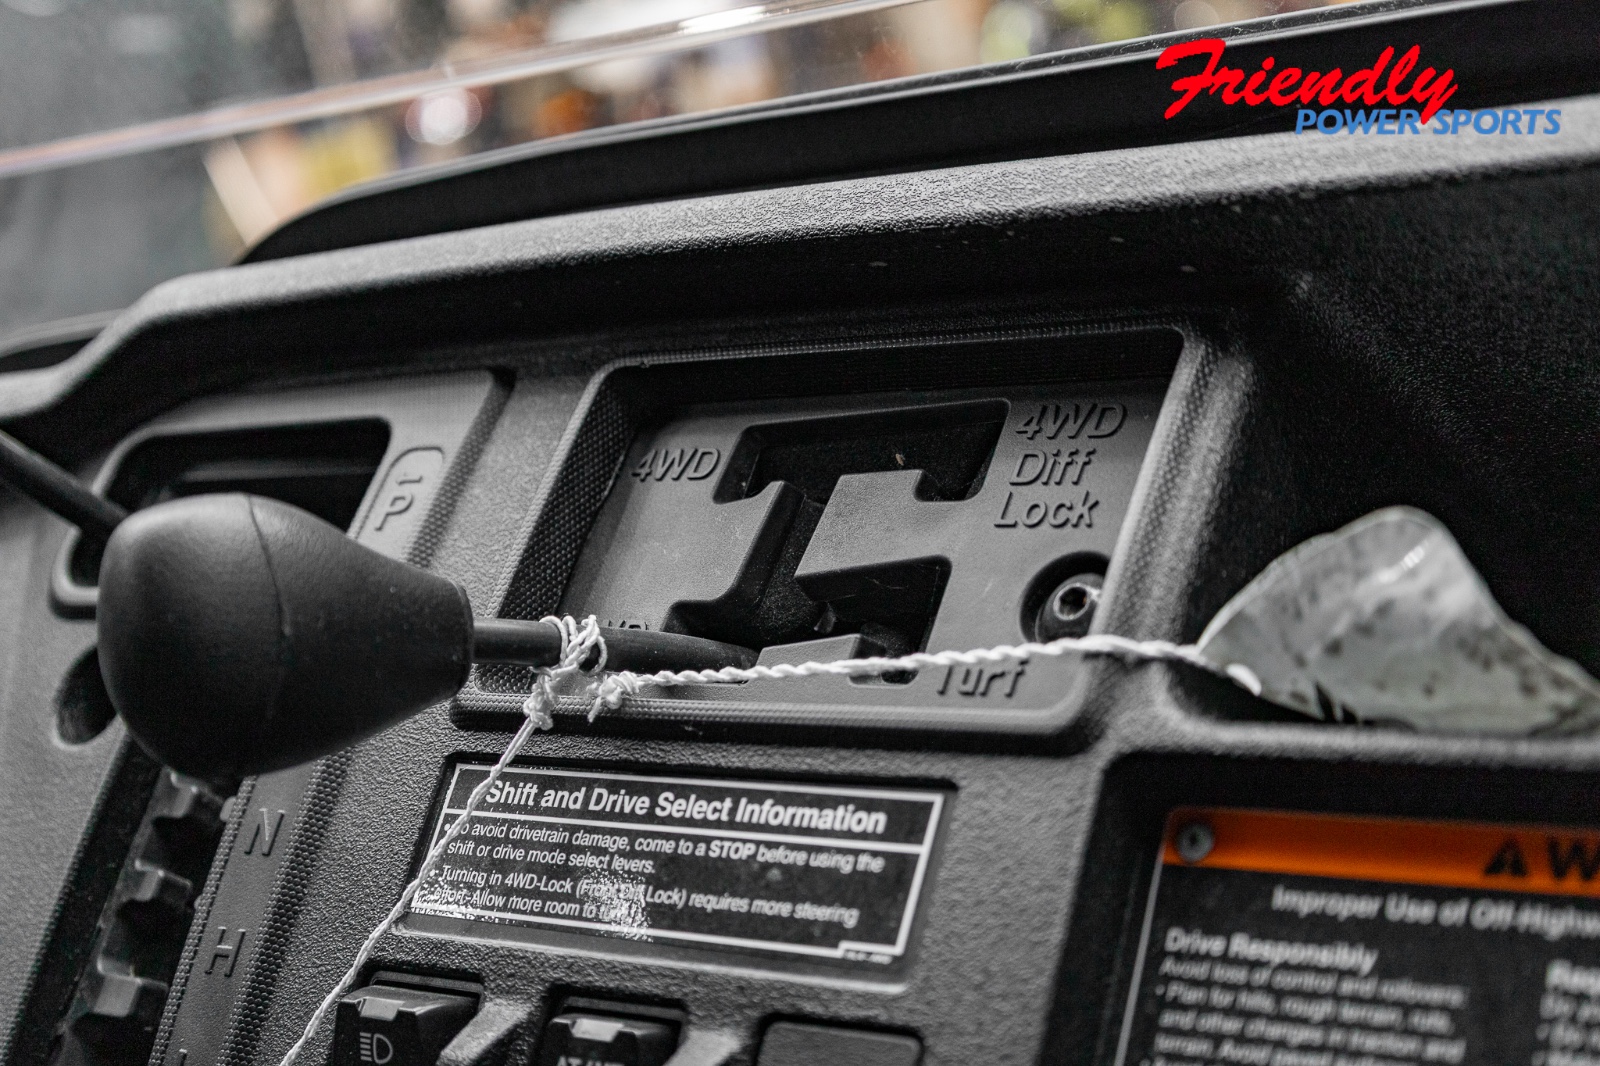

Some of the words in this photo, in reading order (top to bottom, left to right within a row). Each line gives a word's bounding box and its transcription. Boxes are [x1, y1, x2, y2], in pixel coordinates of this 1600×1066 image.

[1015, 403, 1128, 440] 4WD
[631, 446, 721, 483] 4WD
[1008, 447, 1098, 486] Diff
[374, 491, 414, 532] P
[993, 490, 1100, 528] Lock
[485, 780, 538, 806] Shift
[541, 787, 586, 810] and
[588, 788, 650, 815] Drive
[654, 791, 733, 822] Select
[735, 797, 888, 834] Information
[244, 808, 286, 857] N
[472, 822, 509, 838] avoid
[509, 824, 571, 844] drivetrain
[572, 829, 631, 852] damage,
[634, 837, 676, 854] come
[678, 838, 693, 855] to
[694, 842, 706, 857] a
[708, 839, 756, 860] STOP
[756, 844, 808, 867] before
[809, 850, 855, 874] using
[856, 852, 885, 873] the
[447, 840, 475, 857] shift
[476, 844, 492, 857] or
[492, 843, 525, 861] drive
[526, 847, 567, 865] mode
[568, 851, 610, 870] select
[611, 854, 657, 874] levers.
[441, 865, 488, 888] Turning
[489, 870, 502, 885] in
[504, 871, 574, 895] 4WD-Lock
[645, 885, 688, 909] Lock)
[688, 892, 750, 914] requires
[750, 898, 793, 918] more
[793, 902, 860, 929] steering
[469, 888, 507, 908] Allow
[508, 895, 543, 913] more
[544, 899, 580, 917] room
[582, 902, 597, 919] to
[1271, 884, 1383, 921] Improper
[1384, 894, 1436, 927] Use
[1437, 898, 1471, 928] of
[204, 925, 246, 978] H
[1164, 926, 1228, 958] Drive
[1228, 931, 1380, 977] Responsibly
